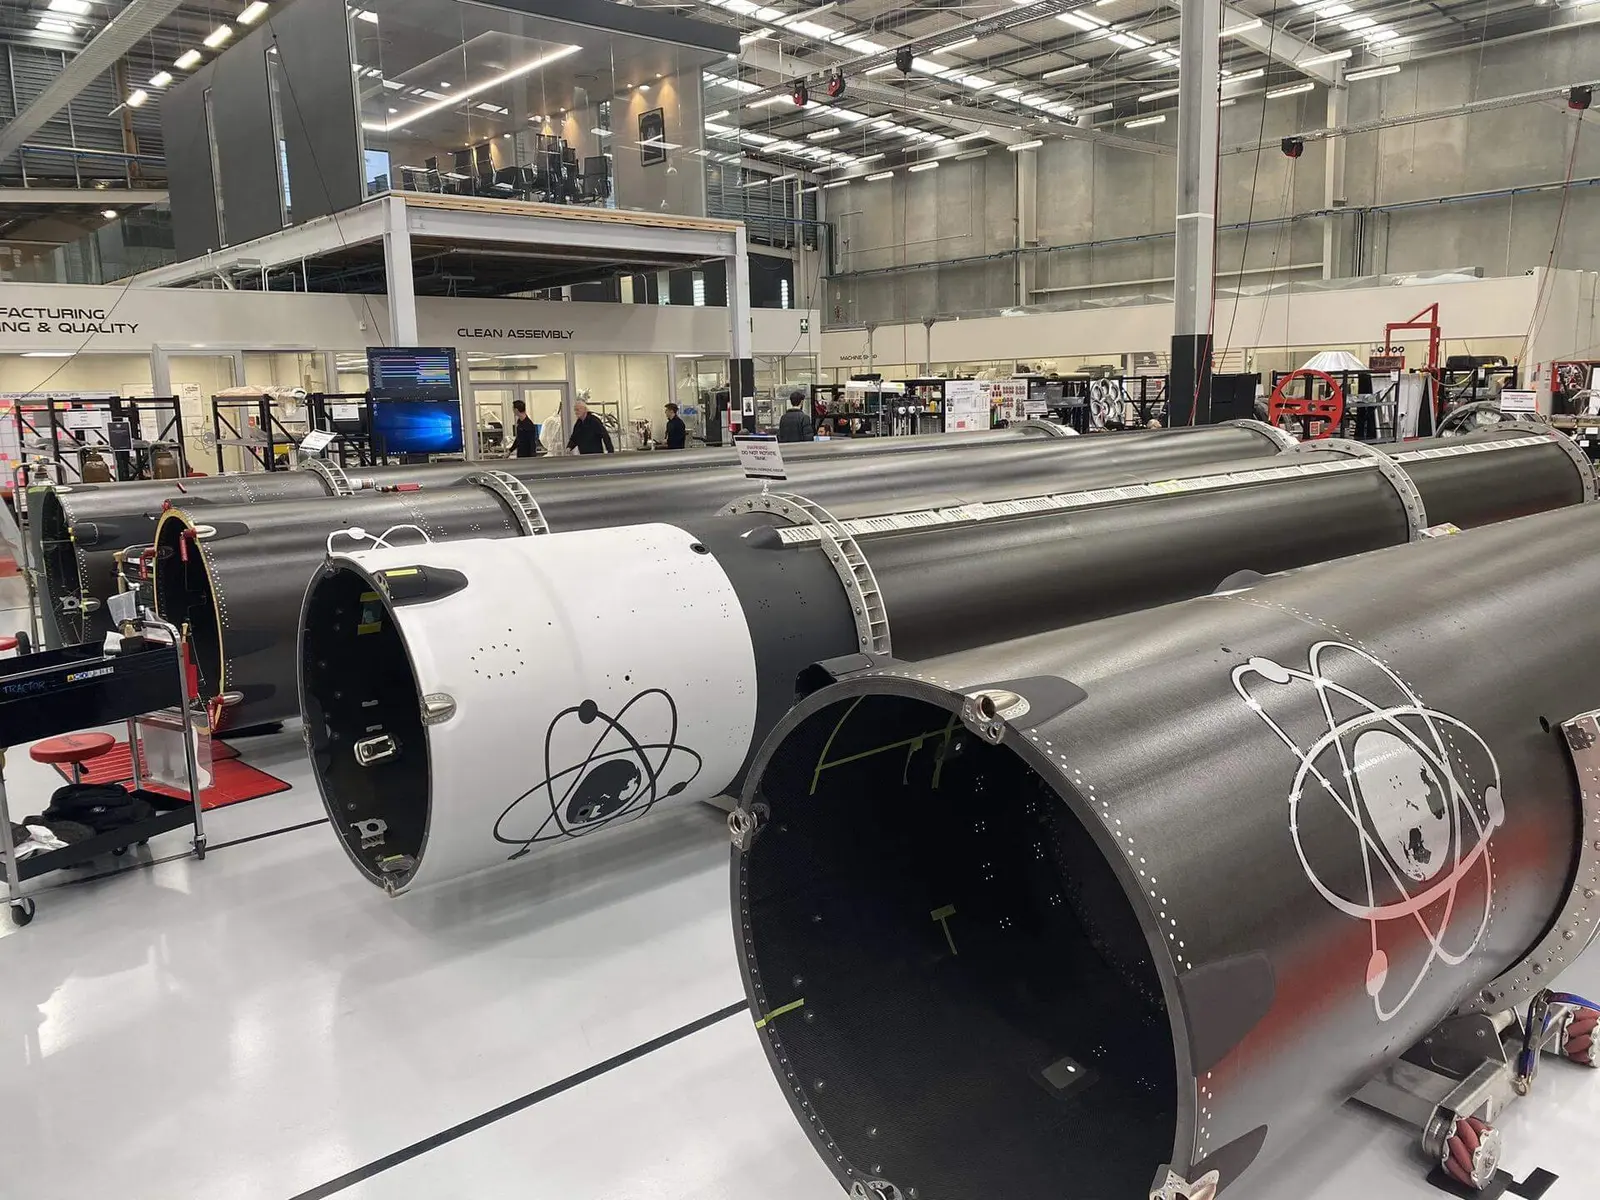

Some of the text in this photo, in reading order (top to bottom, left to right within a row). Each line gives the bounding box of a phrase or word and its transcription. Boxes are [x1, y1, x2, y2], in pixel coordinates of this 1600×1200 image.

[38, 323, 52, 334] &
[58, 323, 139, 334] QUALITY
[457, 328, 575, 340] CLEAN ASSEMBLY
[3, 681, 45, 693] TRACTOR
